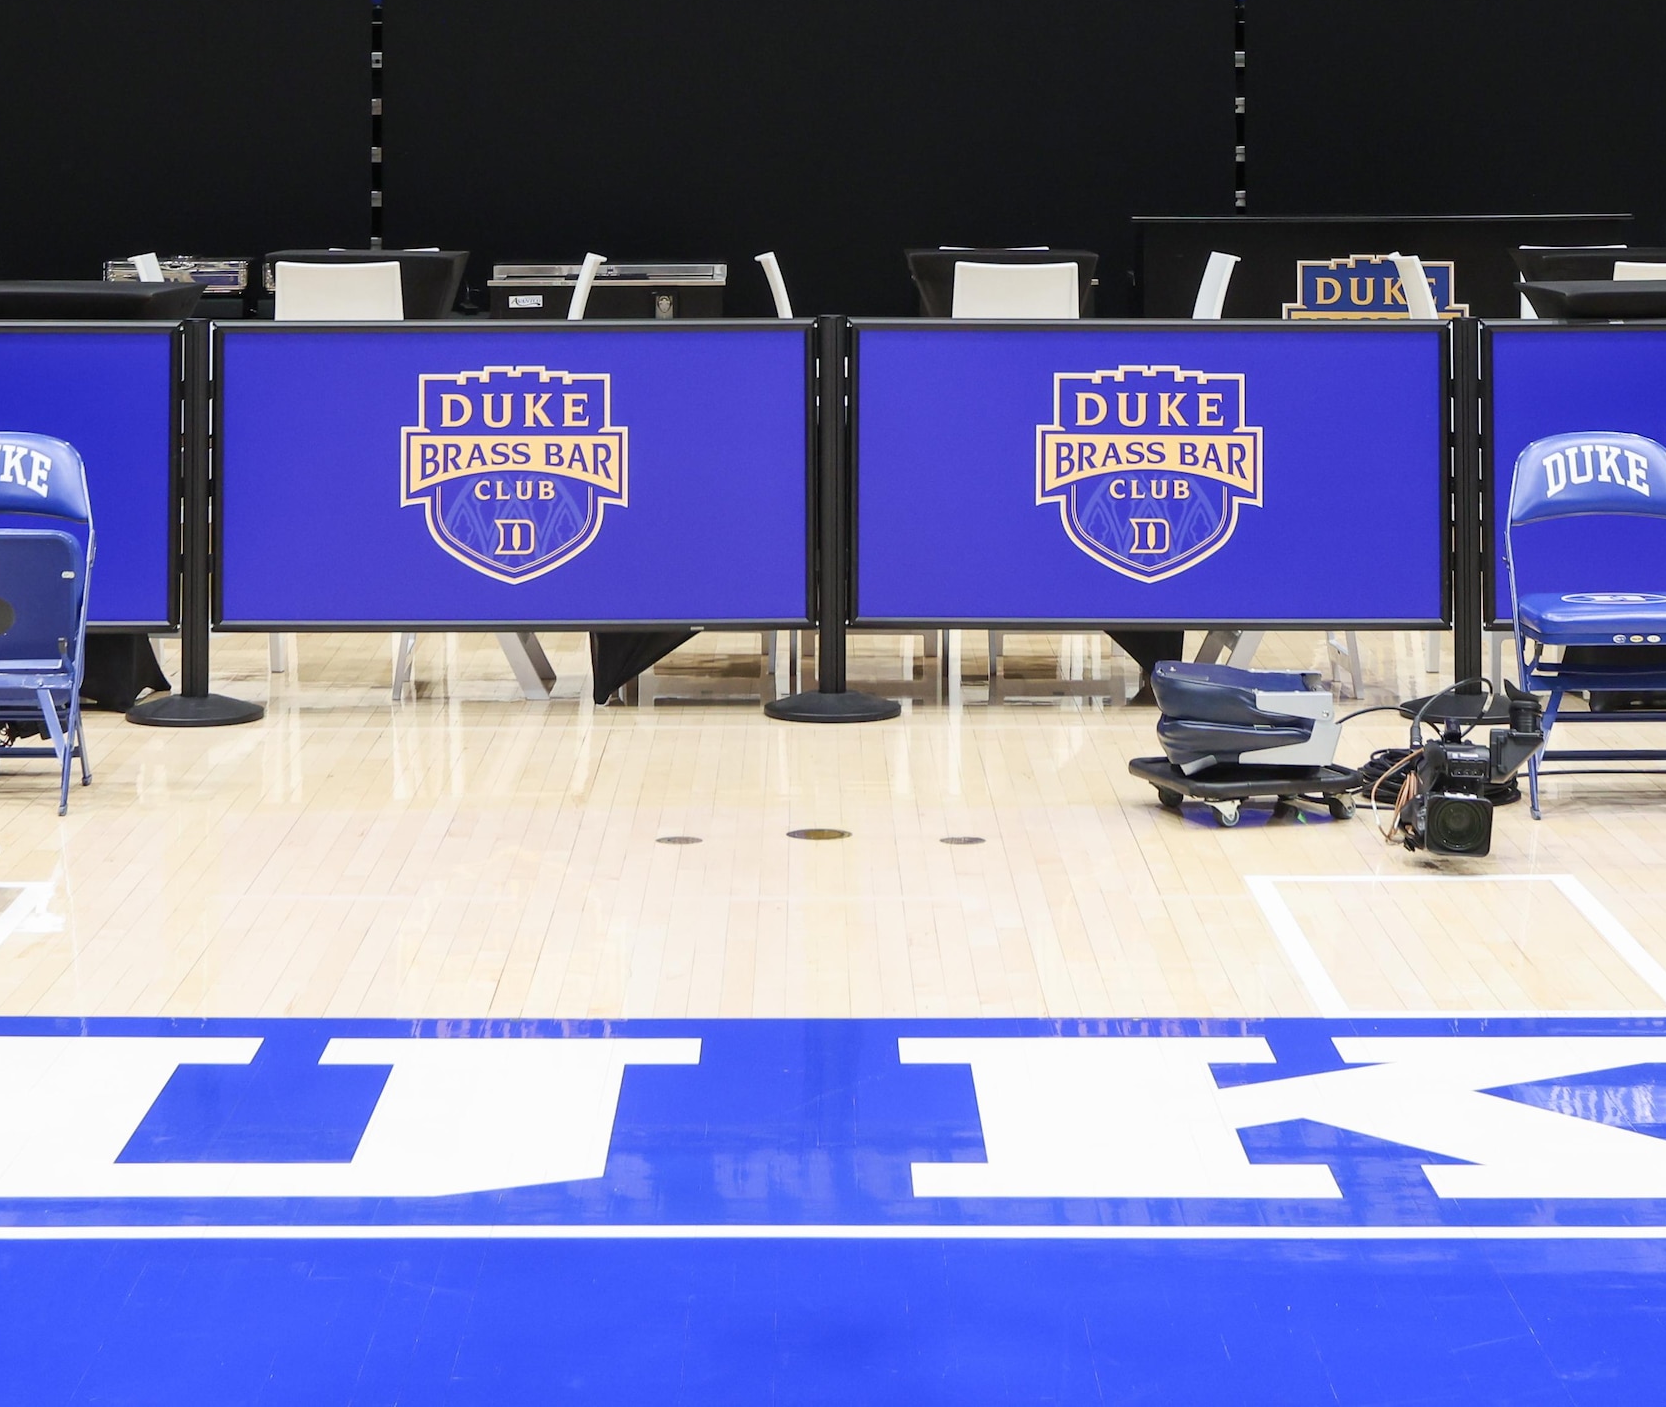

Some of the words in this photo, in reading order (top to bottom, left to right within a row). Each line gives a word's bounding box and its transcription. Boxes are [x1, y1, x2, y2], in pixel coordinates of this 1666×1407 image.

[440, 393, 590, 428] DUKE
[1075, 392, 1224, 427] DUKE
[420, 443, 530, 480] BRASS
[544, 443, 612, 480] BAR
[1055, 442, 1166, 479] BRASS
[1179, 442, 1248, 480] BAR
[1541, 444, 1650, 498] DUKE
[474, 480, 555, 500] CLUB
[1109, 479, 1190, 499] CLUB
